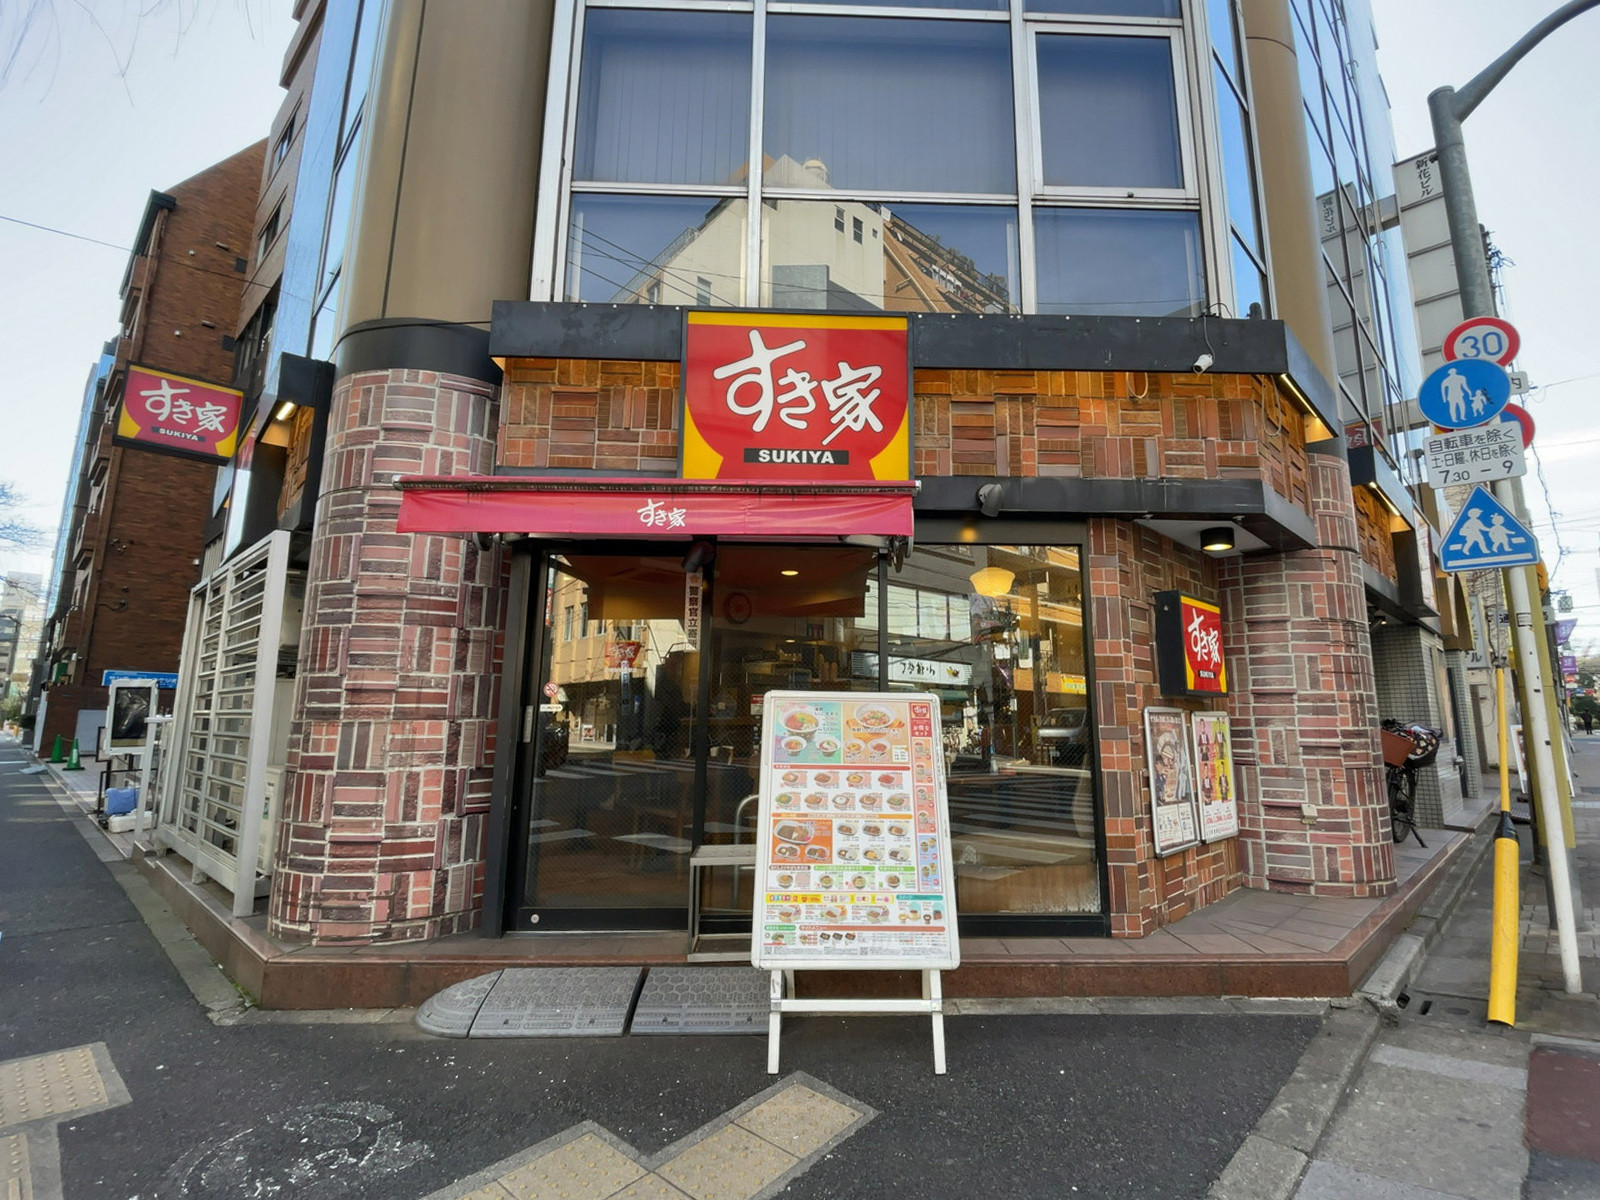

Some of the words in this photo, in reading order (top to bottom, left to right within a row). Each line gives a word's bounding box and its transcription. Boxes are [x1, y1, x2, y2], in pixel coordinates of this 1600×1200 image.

[1461, 331, 1503, 358] 30
[713, 329, 883, 446] すき家
[140, 379, 228, 433] すき家
[159, 428, 199, 441] SUKIYA
[1429, 428, 1515, 453] 自転車を除く
[758, 449, 834, 464] SUKIYA
[1502, 460, 1514, 474] 9
[637, 498, 686, 530] すき家
[687, 586, 699, 649] 警察官立寄所
[1188, 608, 1222, 669] すき家
